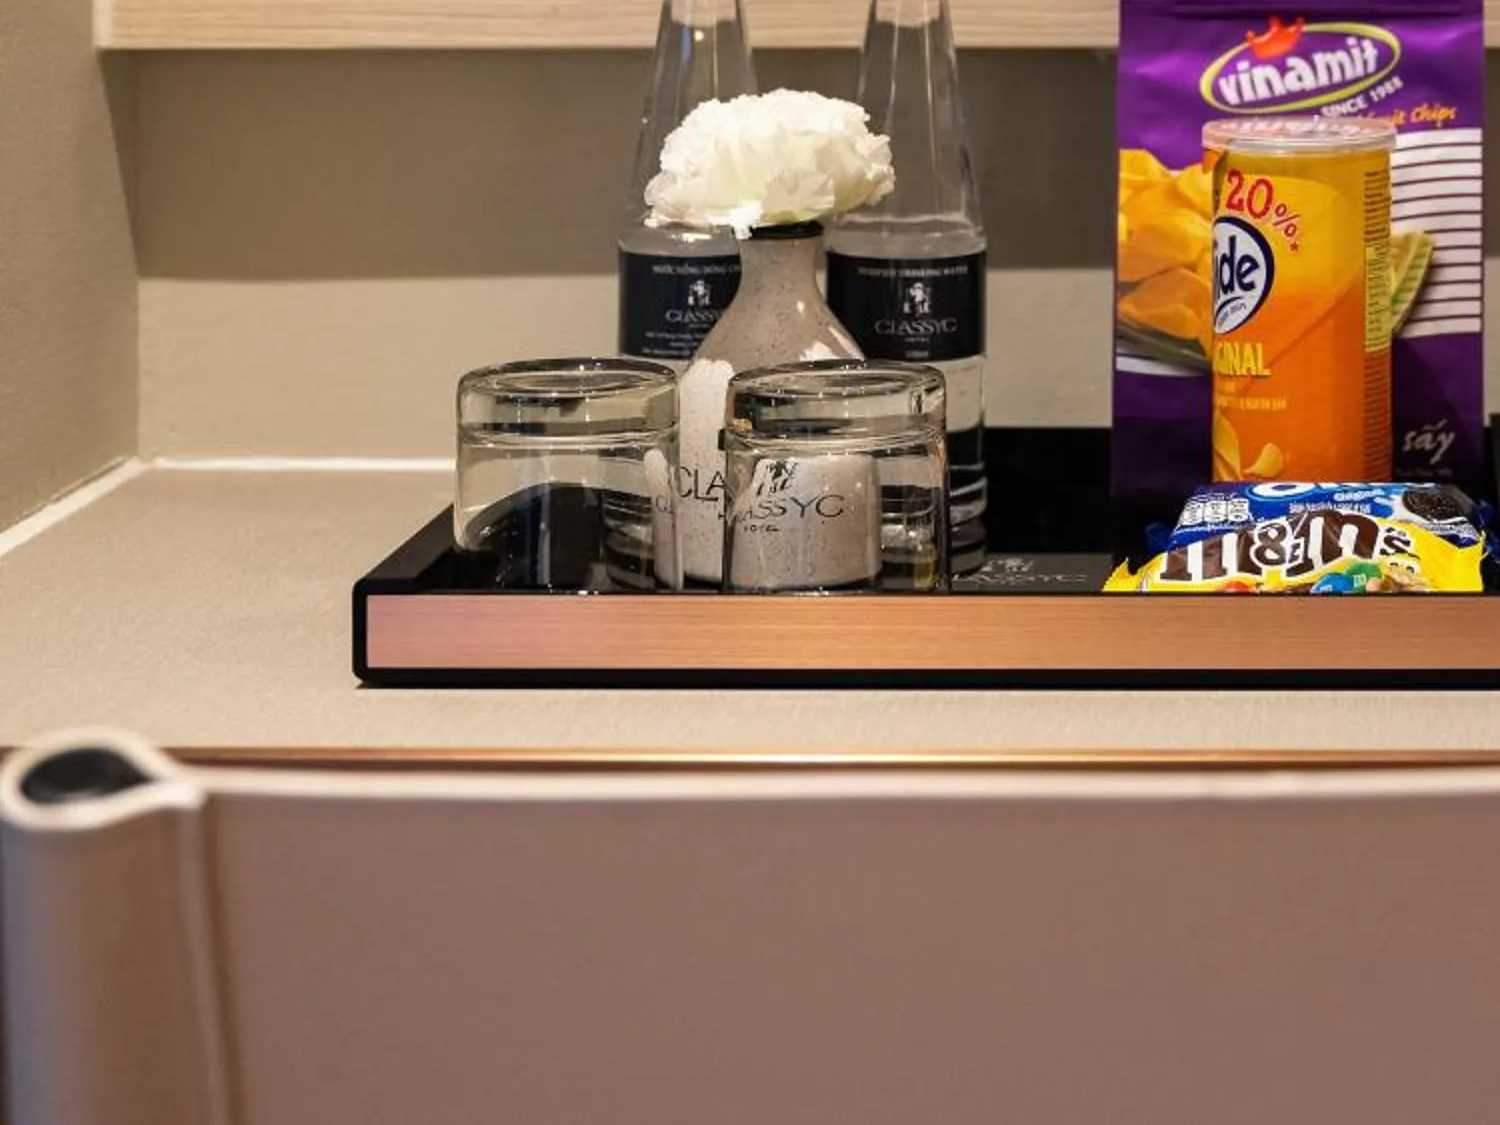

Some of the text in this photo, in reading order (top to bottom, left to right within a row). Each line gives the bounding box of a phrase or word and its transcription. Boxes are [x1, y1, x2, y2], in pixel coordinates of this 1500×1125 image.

[1219, 37, 1379, 106] vinamit
[1321, 95, 1368, 118] SINCE
[1411, 102, 1457, 127] Chips
[875, 317, 958, 336] CLASSYC
[1402, 418, 1456, 465] sấy
